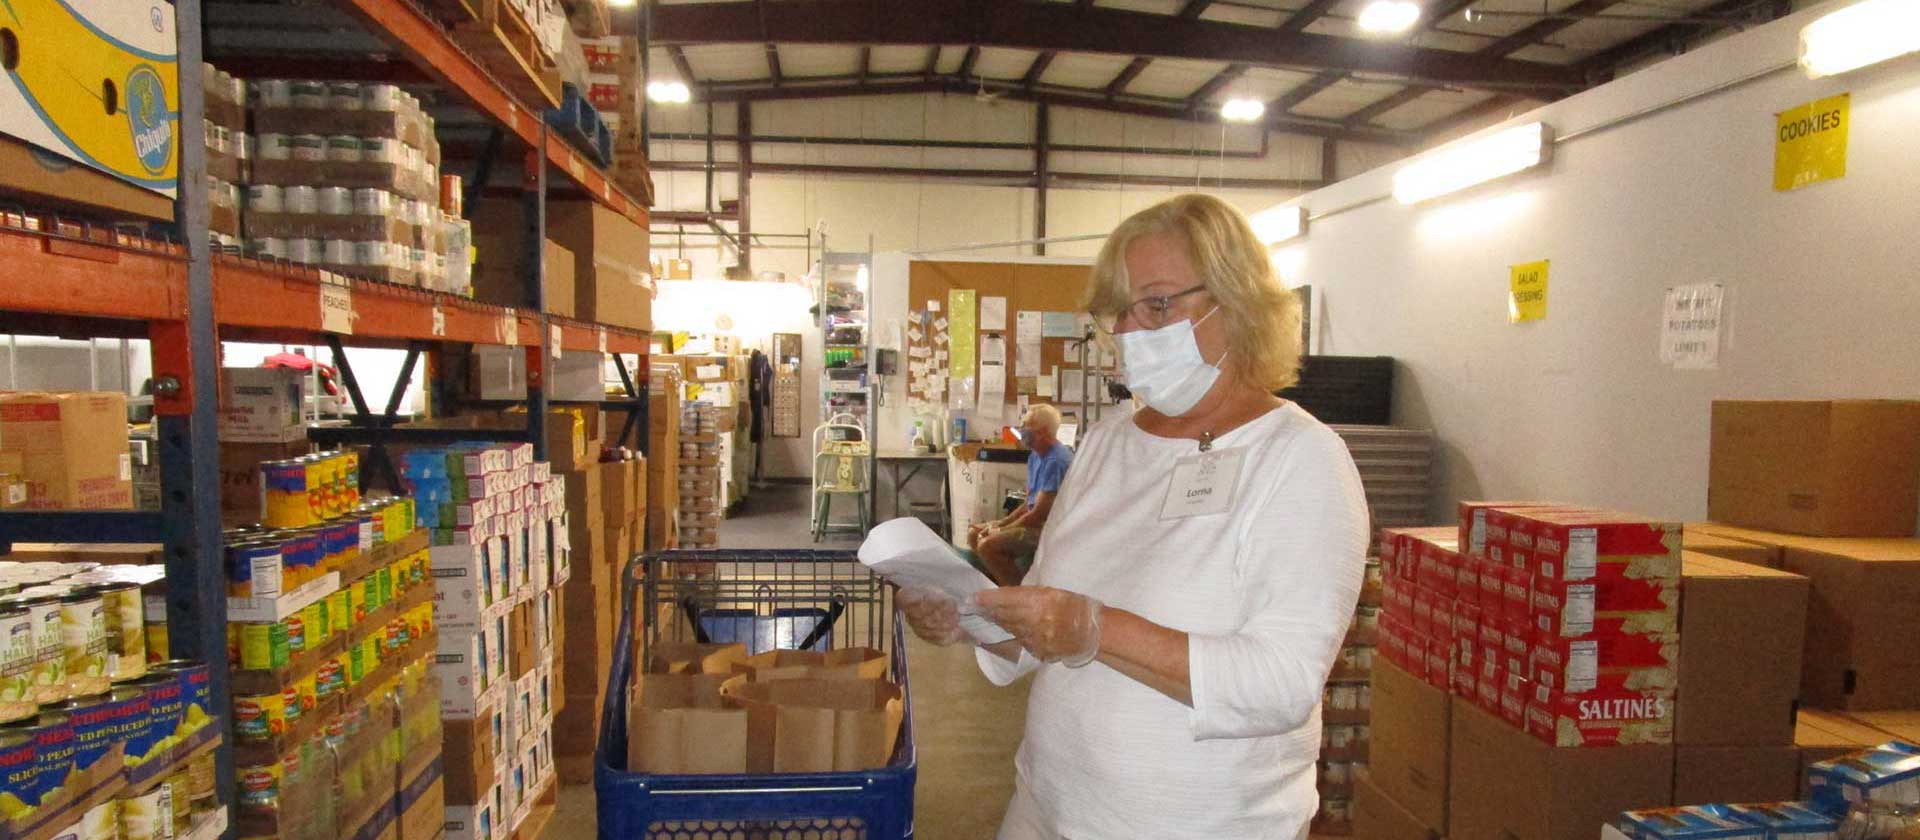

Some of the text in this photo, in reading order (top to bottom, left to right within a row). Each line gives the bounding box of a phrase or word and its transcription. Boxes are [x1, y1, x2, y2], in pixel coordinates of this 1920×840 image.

[135, 116, 171, 158] Chiquita
[1780, 109, 1841, 143] COOKIES
[1579, 699, 1665, 721] SALTINES
